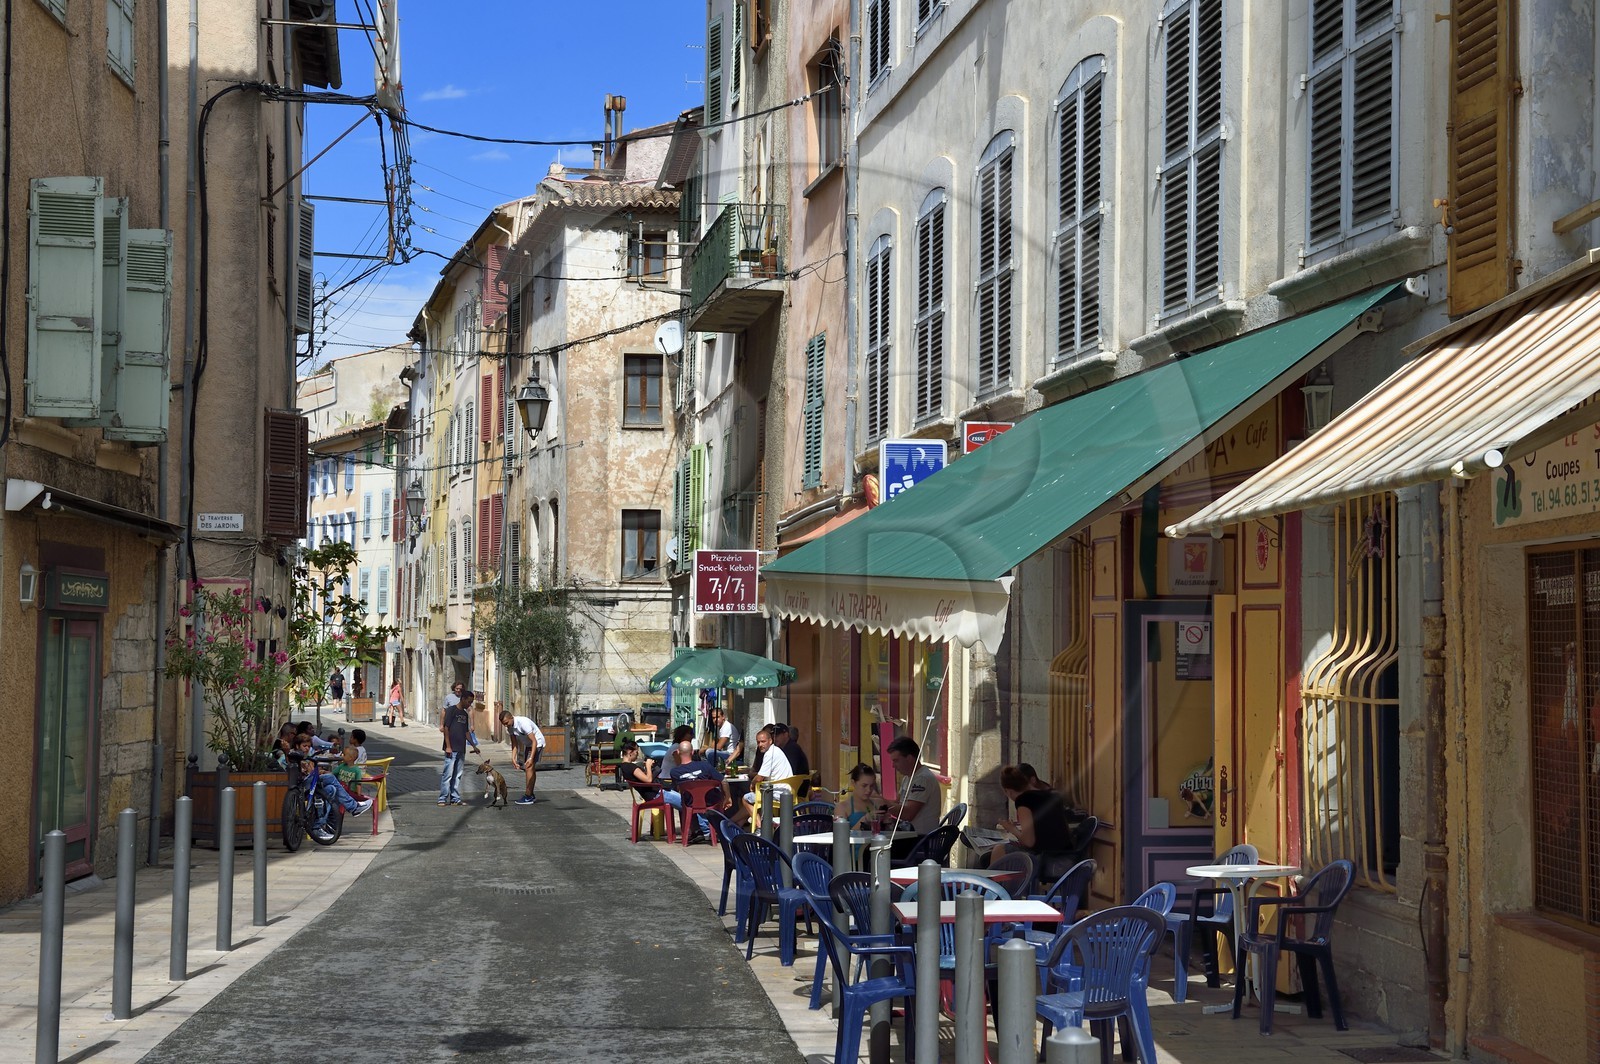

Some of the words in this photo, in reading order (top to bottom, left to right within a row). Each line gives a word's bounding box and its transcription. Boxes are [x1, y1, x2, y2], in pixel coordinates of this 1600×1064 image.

[1246, 420, 1268, 448] Café
[1546, 459, 1580, 480] Coupes
[698, 564, 723, 572] Snack
[729, 564, 755, 572] Kebab
[710, 554, 742, 562] Pizzéria
[708, 575, 745, 602] 7j/7j
[704, 603, 714, 611] 04
[715, 603, 725, 611] 94
[725, 603, 735, 611] 67
[736, 603, 746, 611] 16
[747, 603, 756, 611] 56
[835, 591, 846, 616] LA
[849, 592, 882, 622] TRAPPA
[934, 599, 956, 629] Café
